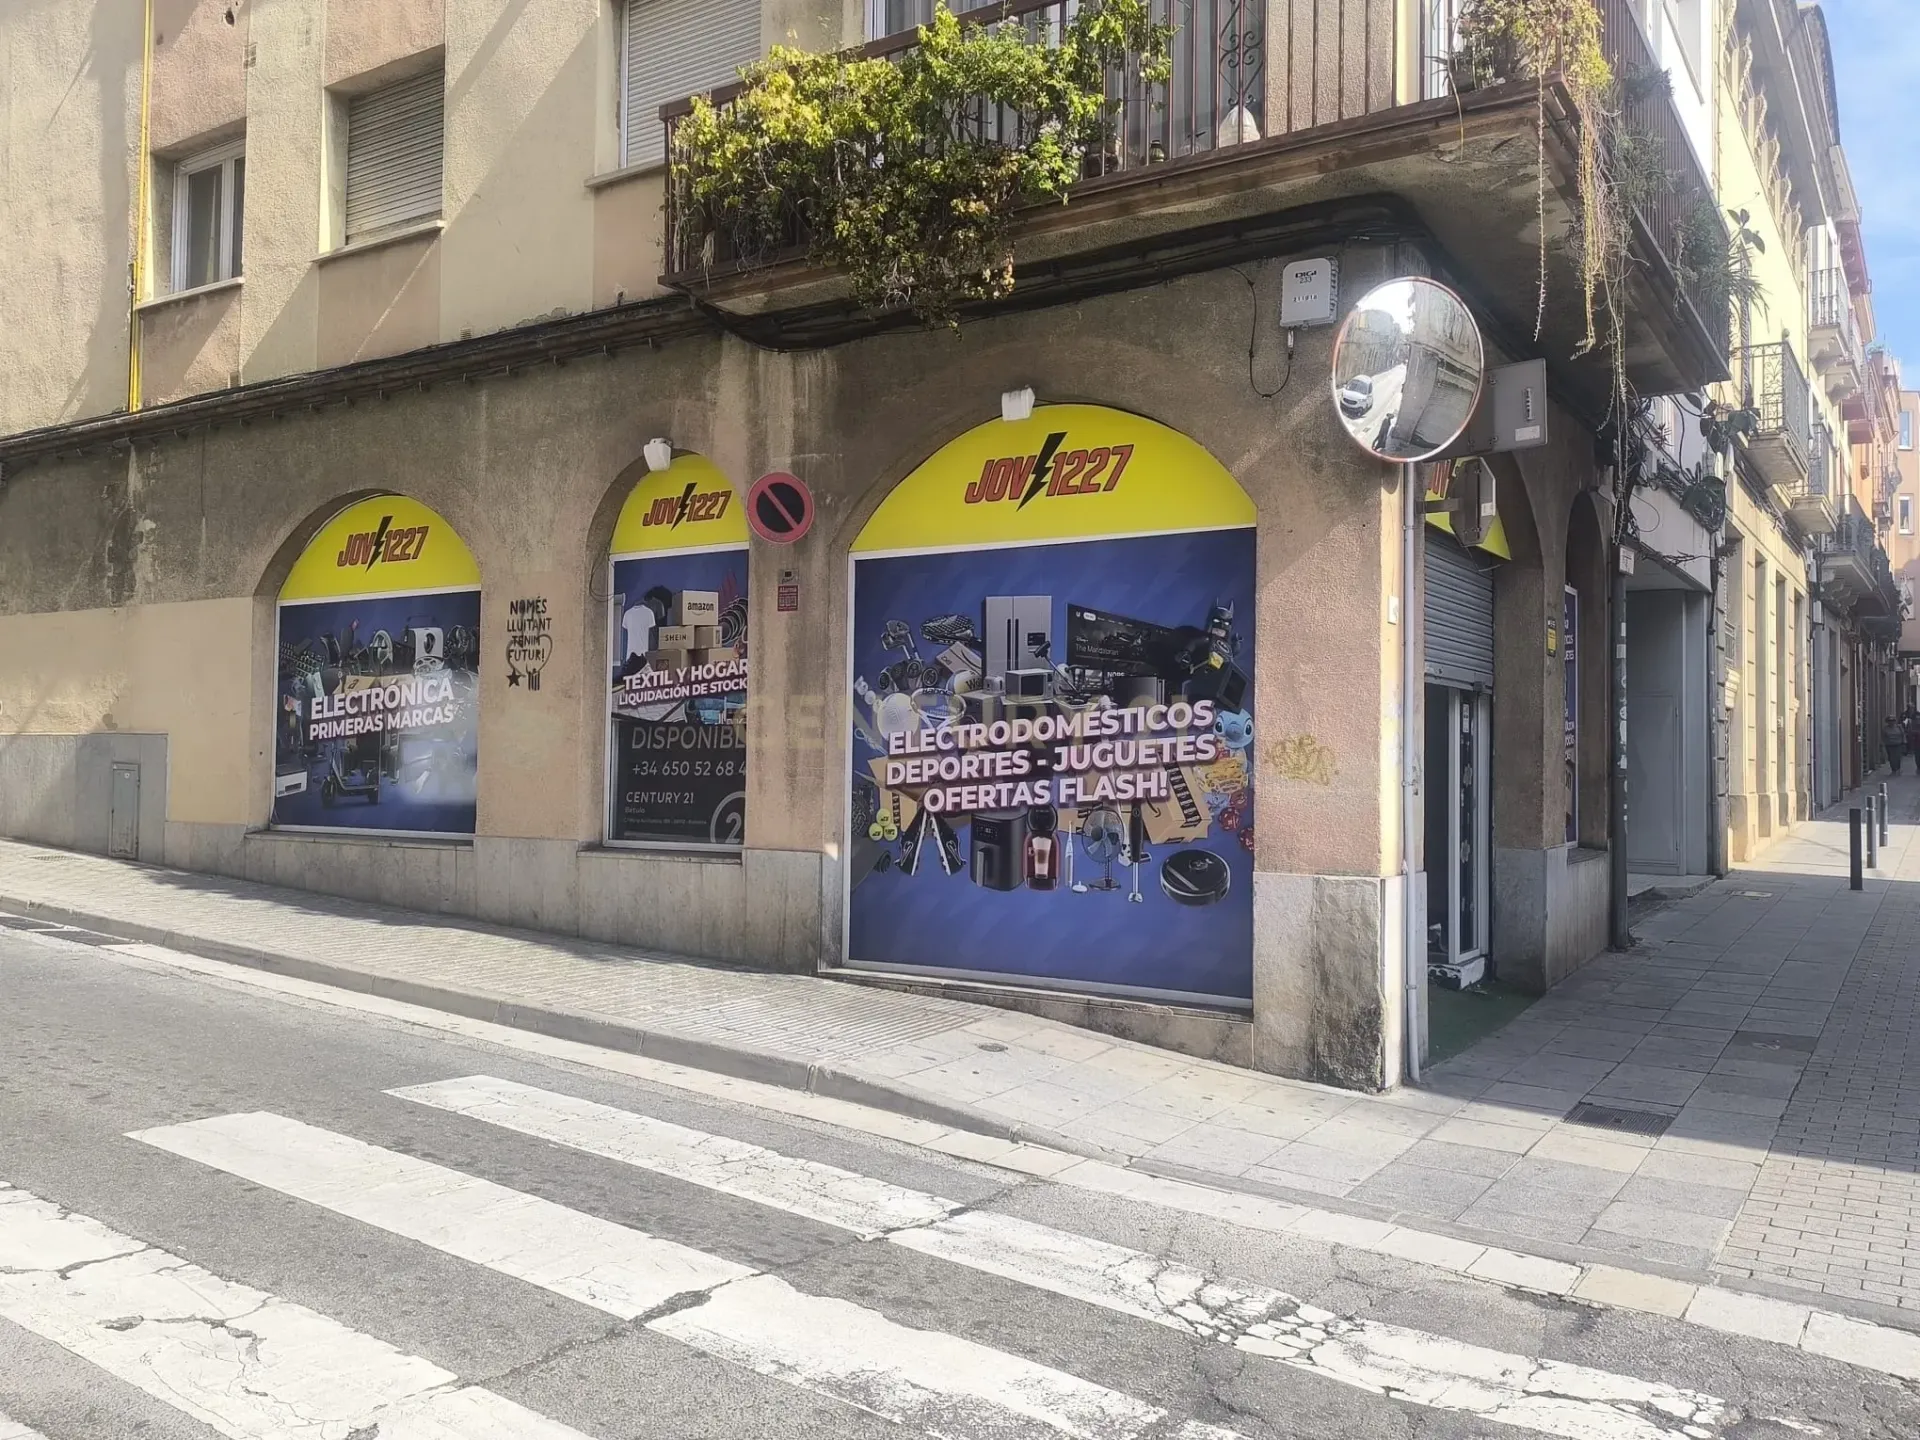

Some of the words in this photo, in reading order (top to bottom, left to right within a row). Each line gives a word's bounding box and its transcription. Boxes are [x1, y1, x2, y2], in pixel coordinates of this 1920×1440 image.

[1295, 270, 1317, 278] DIGI
[509, 596, 547, 615] NOMÉS
[687, 602, 715, 612] amazon
[506, 617, 553, 633] LLUITANT
[664, 634, 687, 642] SHEIN
[507, 648, 545, 662] FUTUR!
[623, 669, 673, 691] TEXTIL
[676, 667, 688, 683] Y
[691, 659, 748, 682] HOGAR
[310, 676, 455, 721] ELECTRÓNICA
[619, 684, 690, 706] LIQUIDACIÓN
[692, 683, 708, 696] DE
[709, 677, 747, 693] STOCK
[309, 713, 384, 741] PRIMERAS
[386, 702, 455, 731] MARCAS
[887, 699, 1215, 757] ELECTRODOMÉSTICOS
[633, 761, 658, 775] +34
[662, 761, 689, 775] 650
[694, 761, 711, 775] 52
[715, 761, 734, 775] 68
[886, 748, 1032, 787] DEPORTES
[1053, 733, 1218, 772] JUGUETES
[626, 791, 681, 804] CENTURY
[683, 792, 694, 804] 21
[923, 777, 1052, 814] OFERTAS
[1058, 771, 1170, 805] FLASH!
